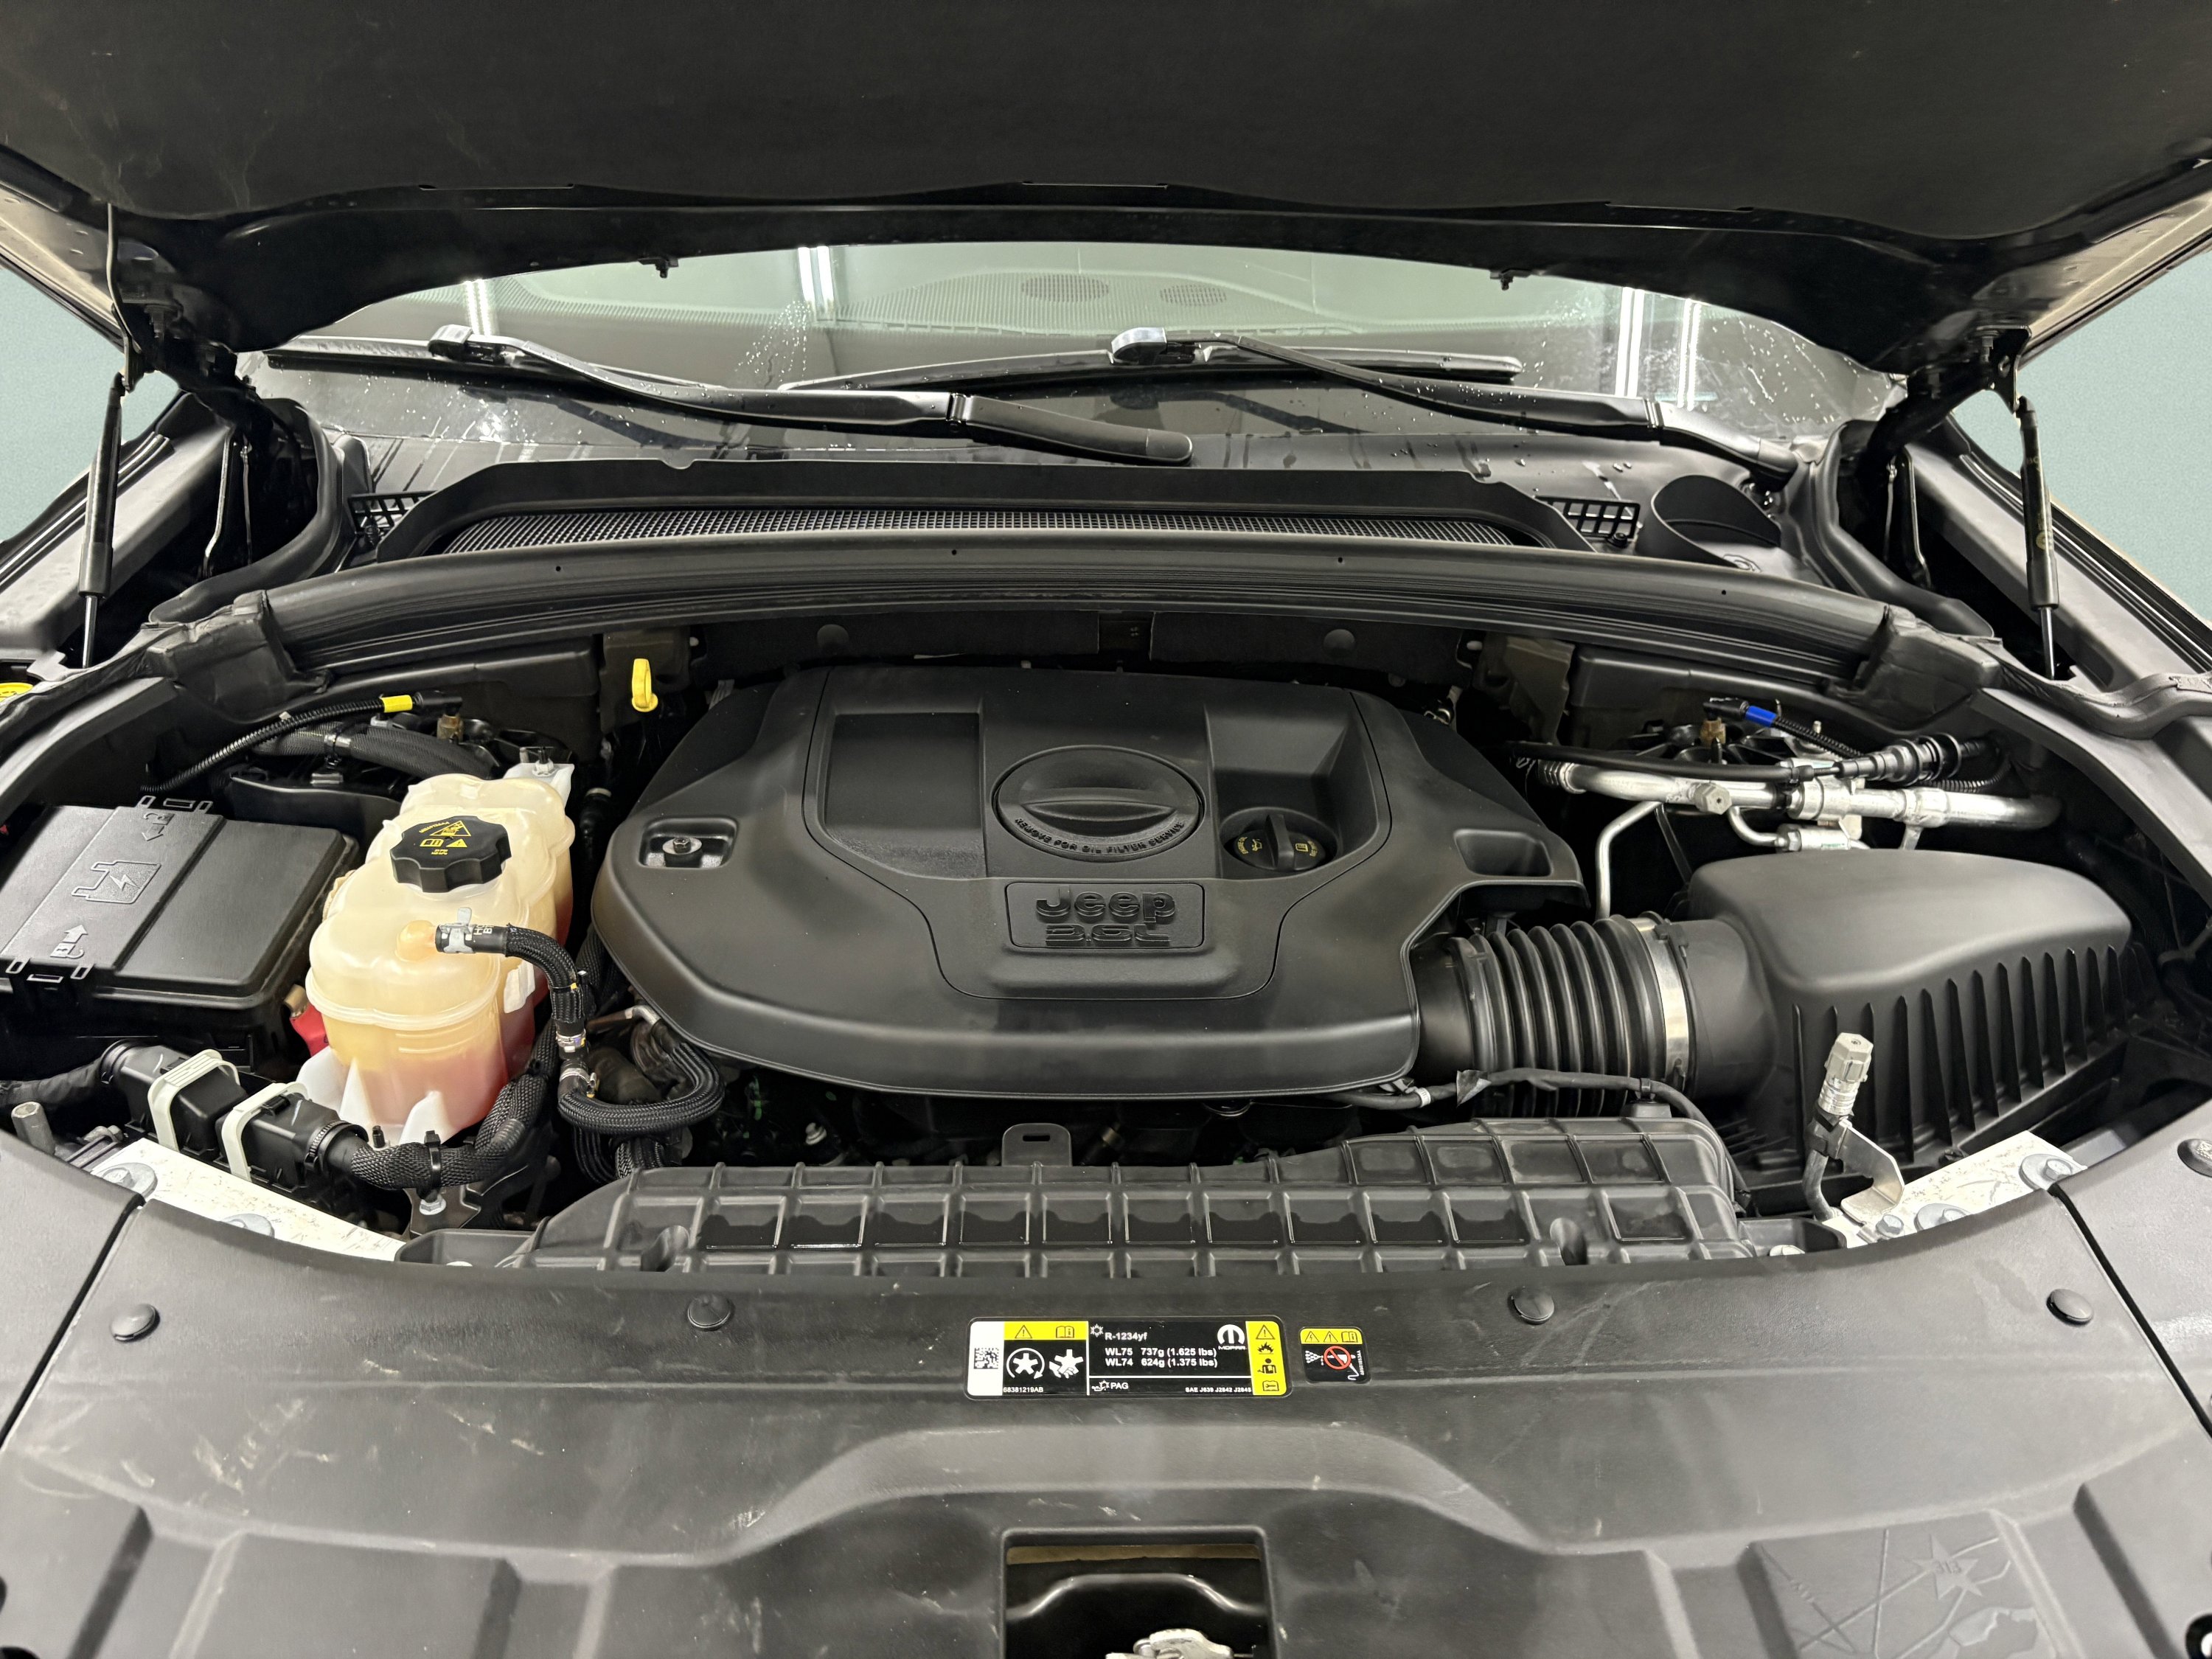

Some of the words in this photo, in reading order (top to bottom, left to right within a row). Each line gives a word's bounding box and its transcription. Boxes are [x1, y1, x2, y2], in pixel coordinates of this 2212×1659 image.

[1015, 818, 1052, 843] REMOVE
[1054, 839, 1077, 850] FOR
[1082, 845, 1102, 854] OIL
[1107, 842, 1147, 854] FILTER
[1148, 821, 1184, 846] SERVICE
[1036, 886, 1175, 923] Jeep
[1046, 924, 1172, 942] 3.6L
[1105, 1332, 1148, 1341] R-1234yf
[1105, 1347, 1133, 1356] WL75
[1141, 1347, 1165, 1357] 737g
[1166, 1347, 1197, 1357] (1.625
[1198, 1347, 1217, 1357] lbs)
[1105, 1358, 1133, 1366] WL74
[1141, 1358, 1165, 1368] 624g
[1167, 1358, 1197, 1368] (1.375
[1199, 1358, 1218, 1368] lbs)
[1110, 1382, 1129, 1390] PAG
